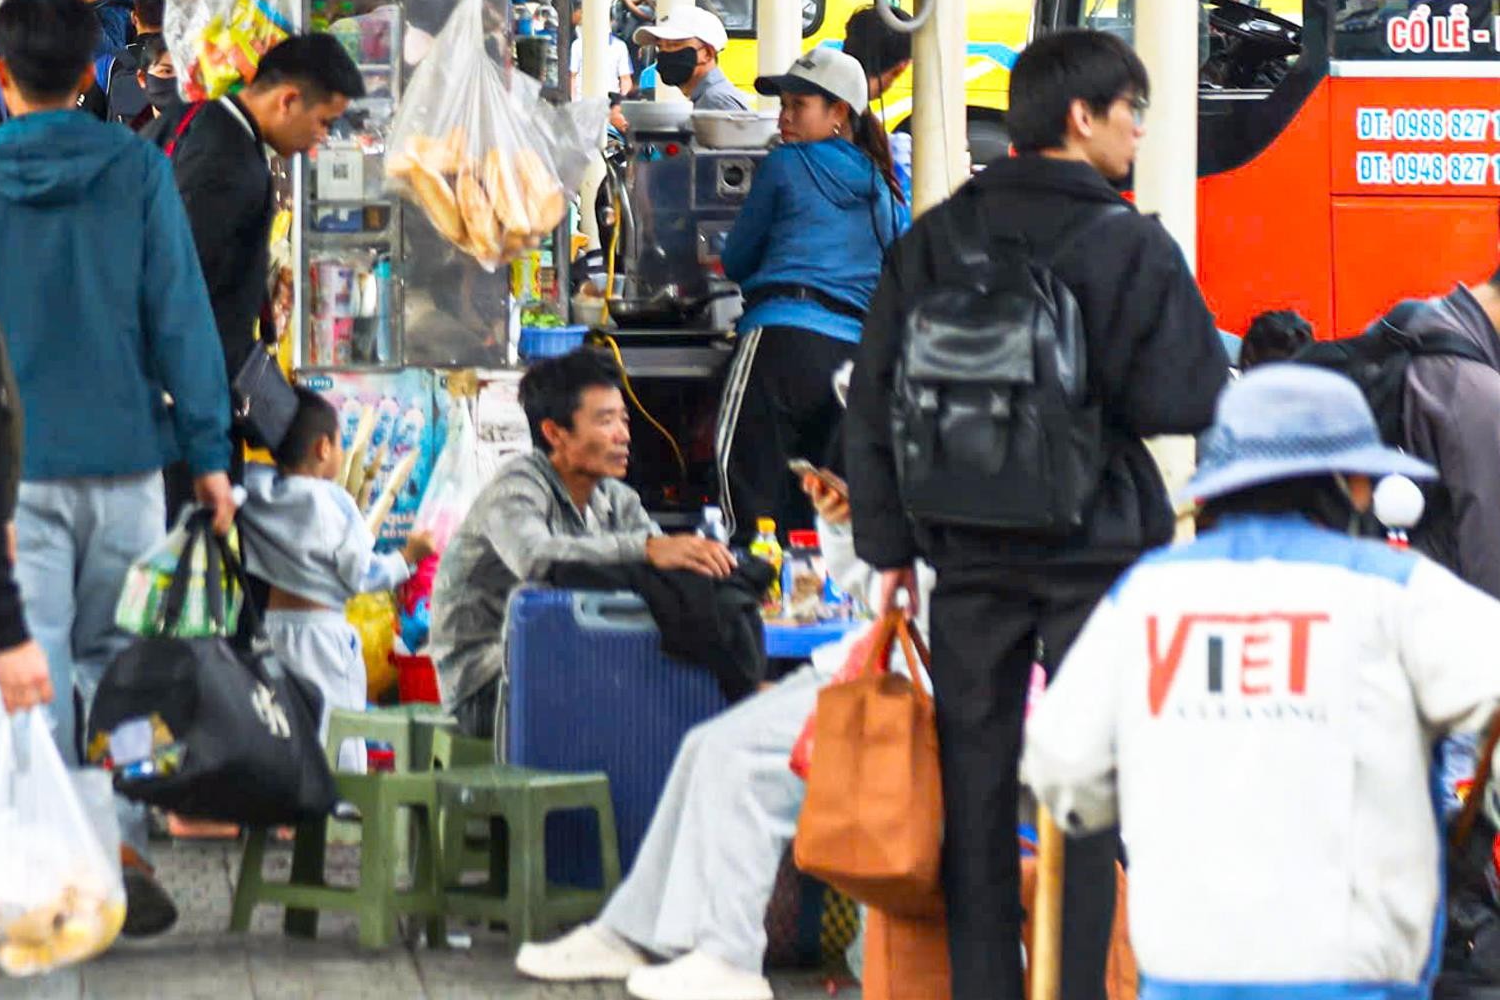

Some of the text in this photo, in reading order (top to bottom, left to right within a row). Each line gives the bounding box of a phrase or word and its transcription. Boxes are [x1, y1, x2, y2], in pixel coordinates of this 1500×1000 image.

[1358, 109, 1488, 140] ĐT: 0988 827
[1357, 152, 1488, 184] ĐT: 0948 827
